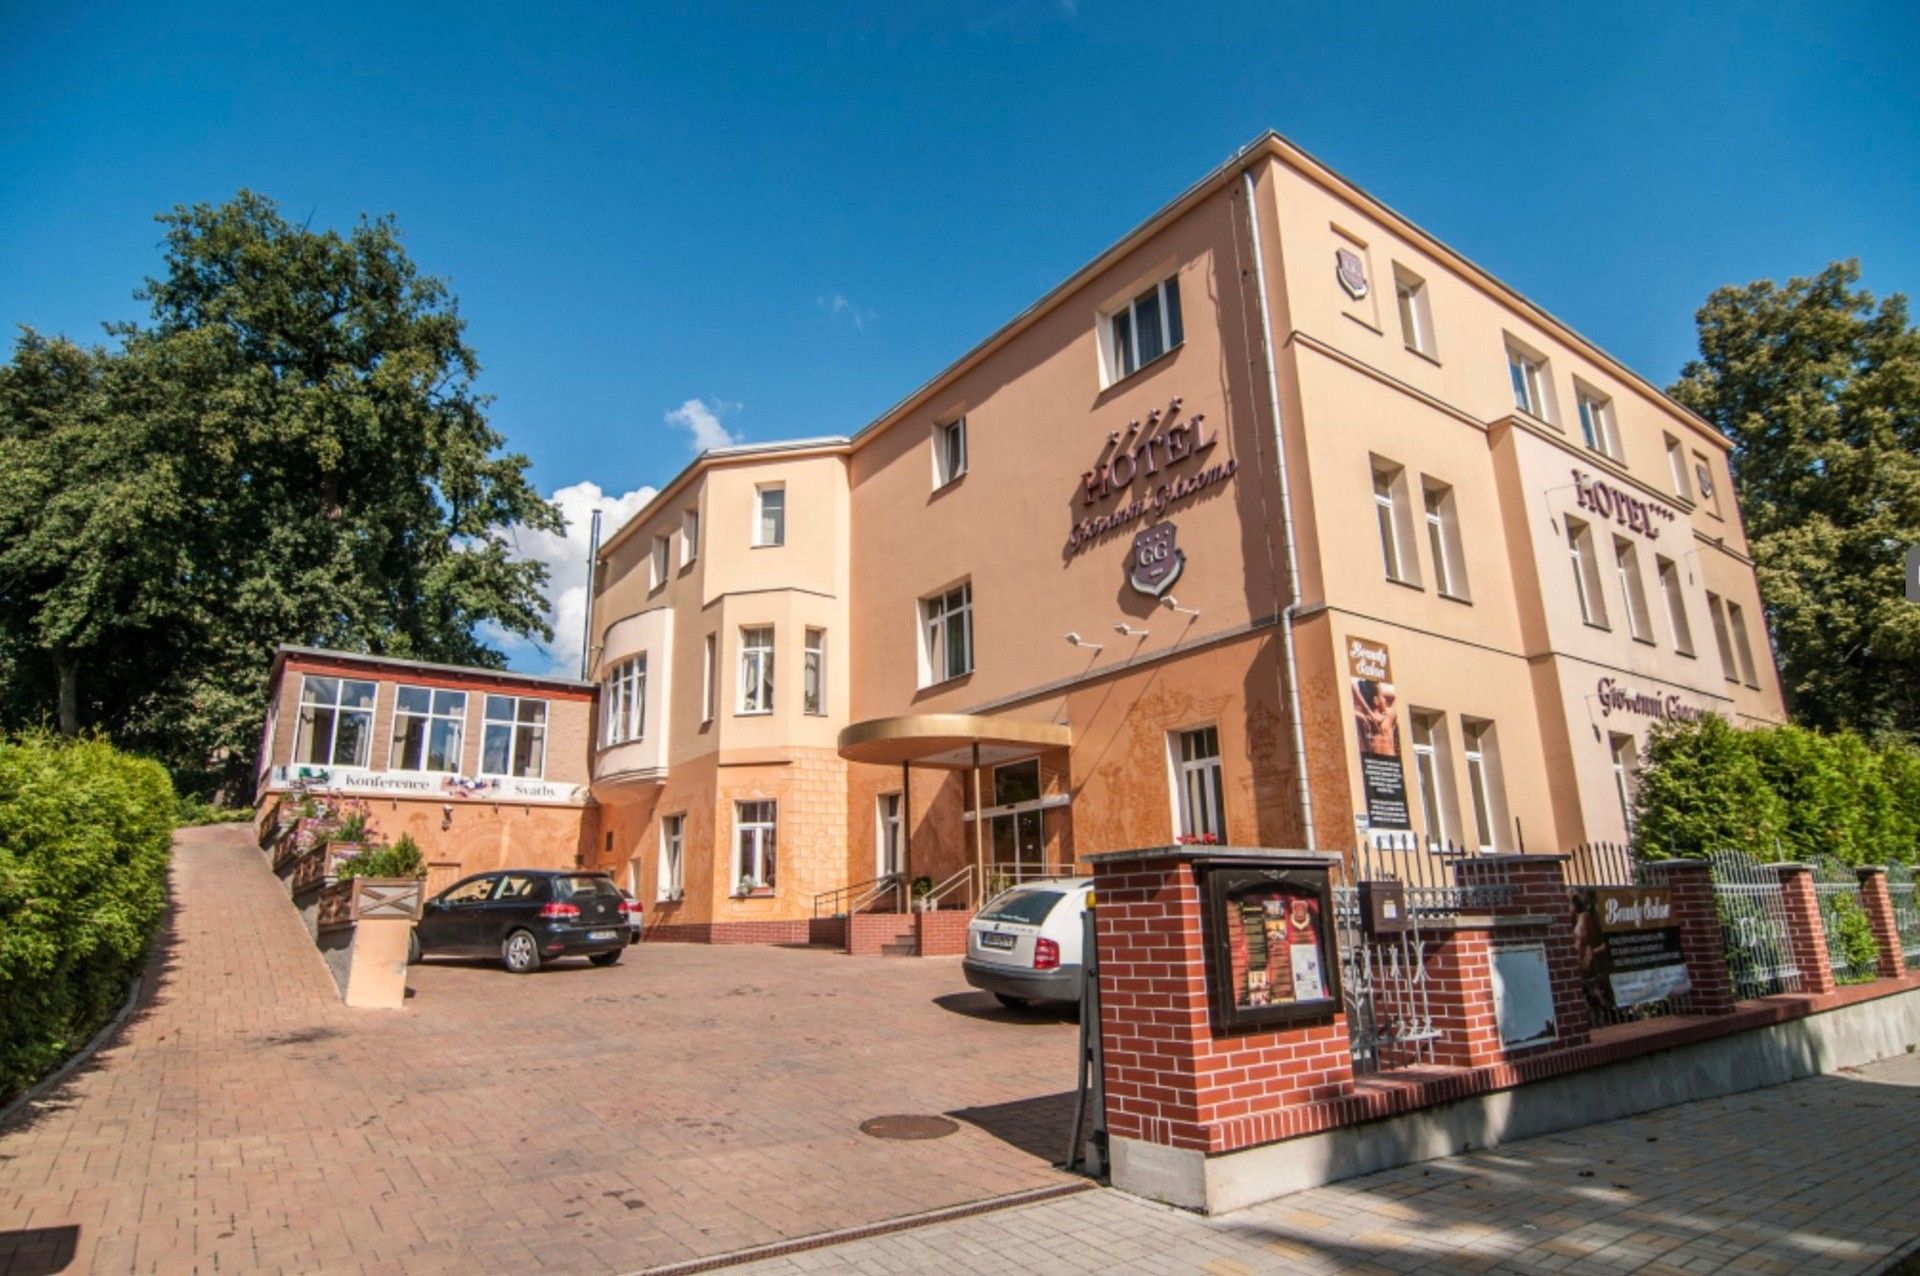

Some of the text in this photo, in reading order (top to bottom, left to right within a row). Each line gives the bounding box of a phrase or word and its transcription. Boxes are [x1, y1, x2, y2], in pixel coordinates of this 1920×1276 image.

[1082, 414, 1219, 507] HOTEL
[1571, 469, 1659, 540] HOTEL
[1597, 677, 1662, 718] Giovanni
[345, 773, 431, 790] Konference
